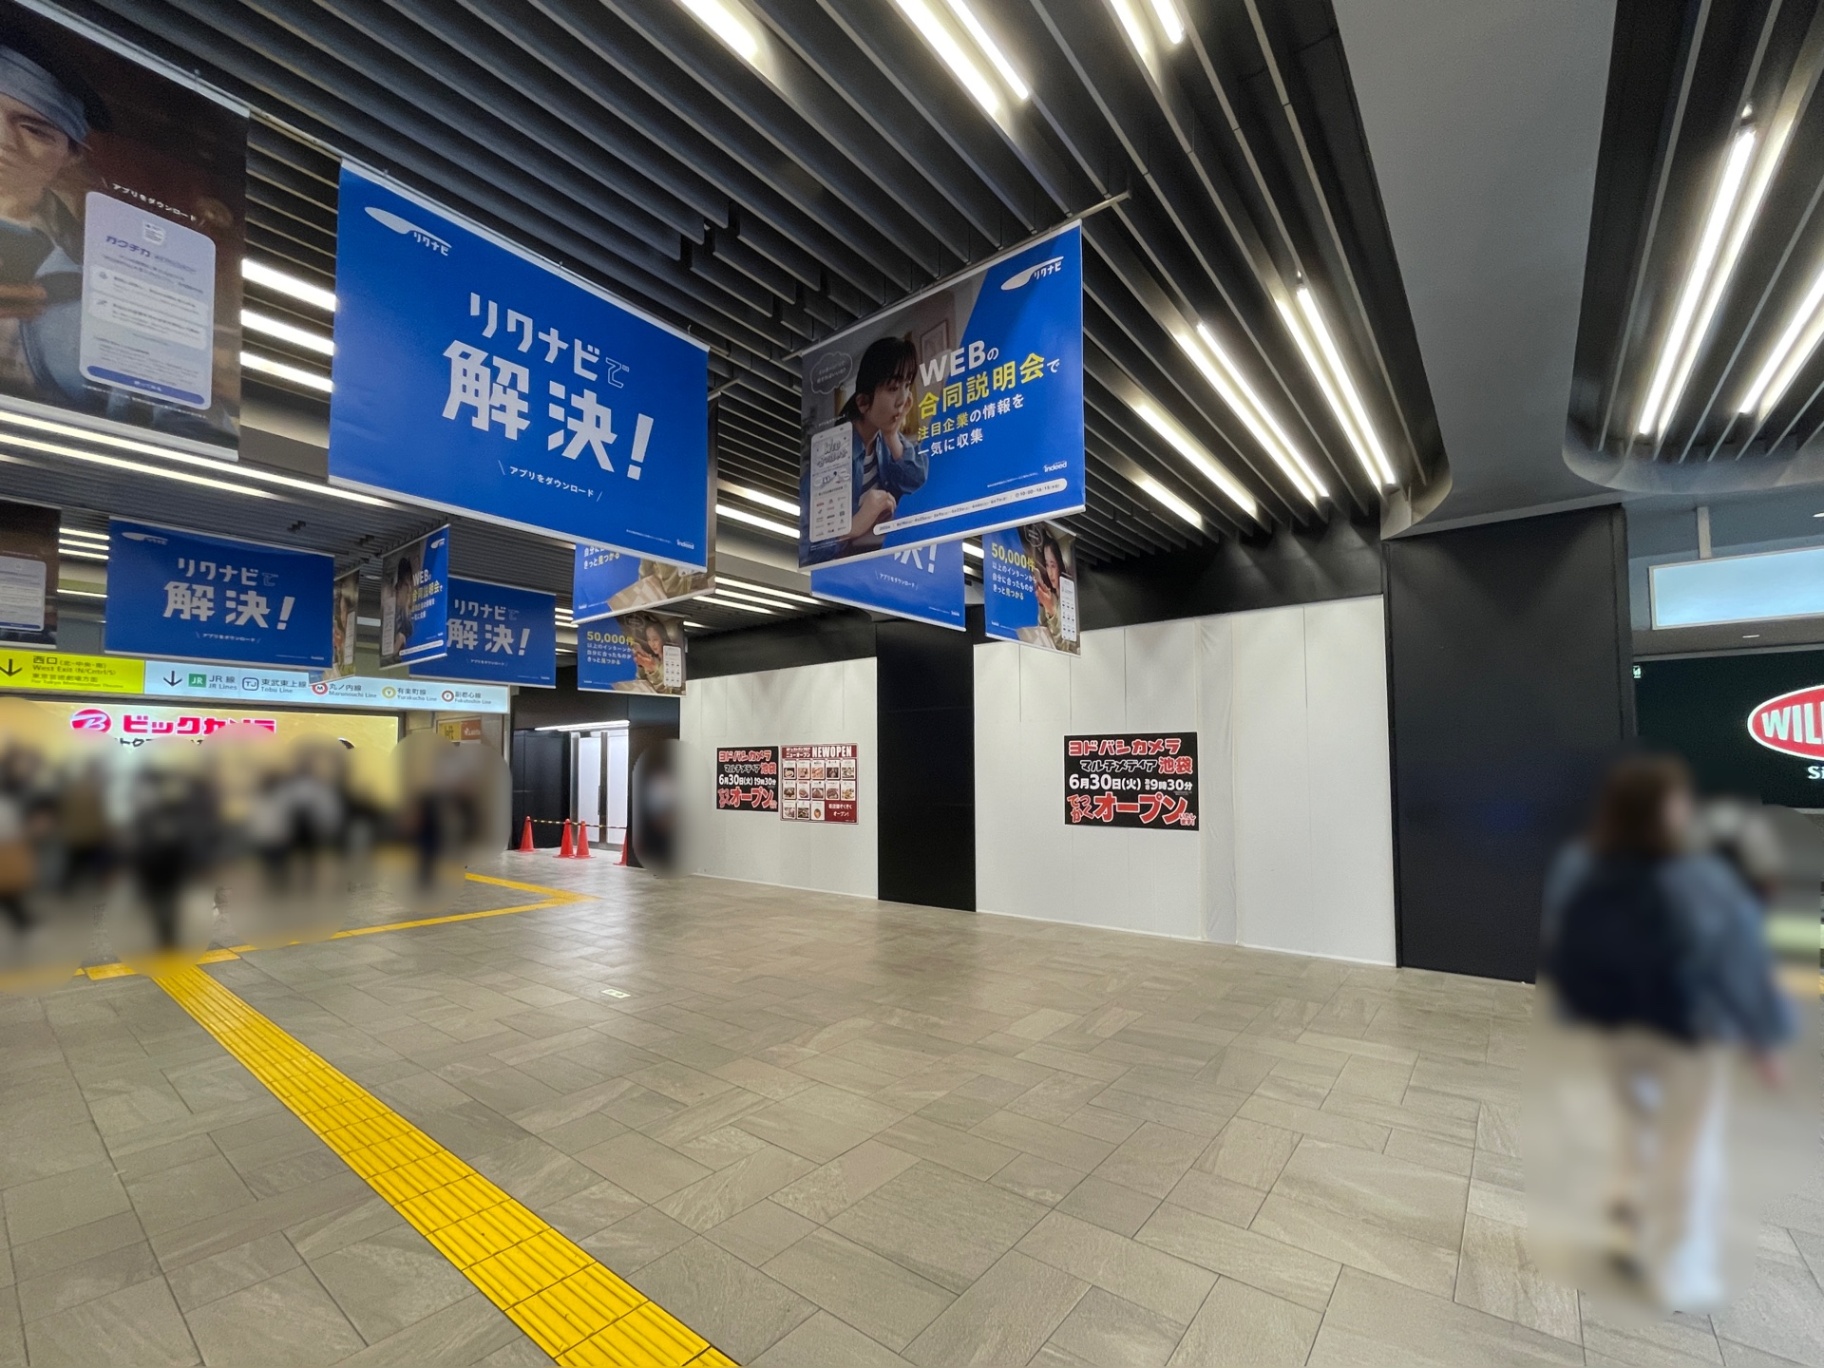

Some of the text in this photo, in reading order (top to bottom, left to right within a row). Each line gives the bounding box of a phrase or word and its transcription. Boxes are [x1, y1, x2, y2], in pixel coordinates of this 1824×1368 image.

[413, 231, 450, 256] リクナビ
[1033, 261, 1062, 280] リクナビ
[470, 292, 630, 389] リクナビで
[919, 340, 999, 387] WEBの
[918, 352, 1061, 420] 合同説明会で
[442, 339, 654, 480] 解決!
[917, 394, 1025, 442] 注目企業の情報を
[917, 427, 983, 457] 一気に収集
[509, 466, 594, 498] アプリをダウンロード
[178, 558, 279, 587] リクナビで
[163, 581, 296, 630] 解決!
[455, 599, 520, 621] リクナビで
[446, 618, 531, 656] 解決!
[191, 677, 203, 685] JR
[261, 678, 307, 688] 東武東上線
[329, 683, 362, 692] 丸ノ内線
[1761, 701, 1824, 745] WIL
[1068, 738, 1181, 756] ヨドバシカメラ
[1069, 774, 1141, 790] 6月30日(火)
[1093, 791, 1188, 824] オープン
